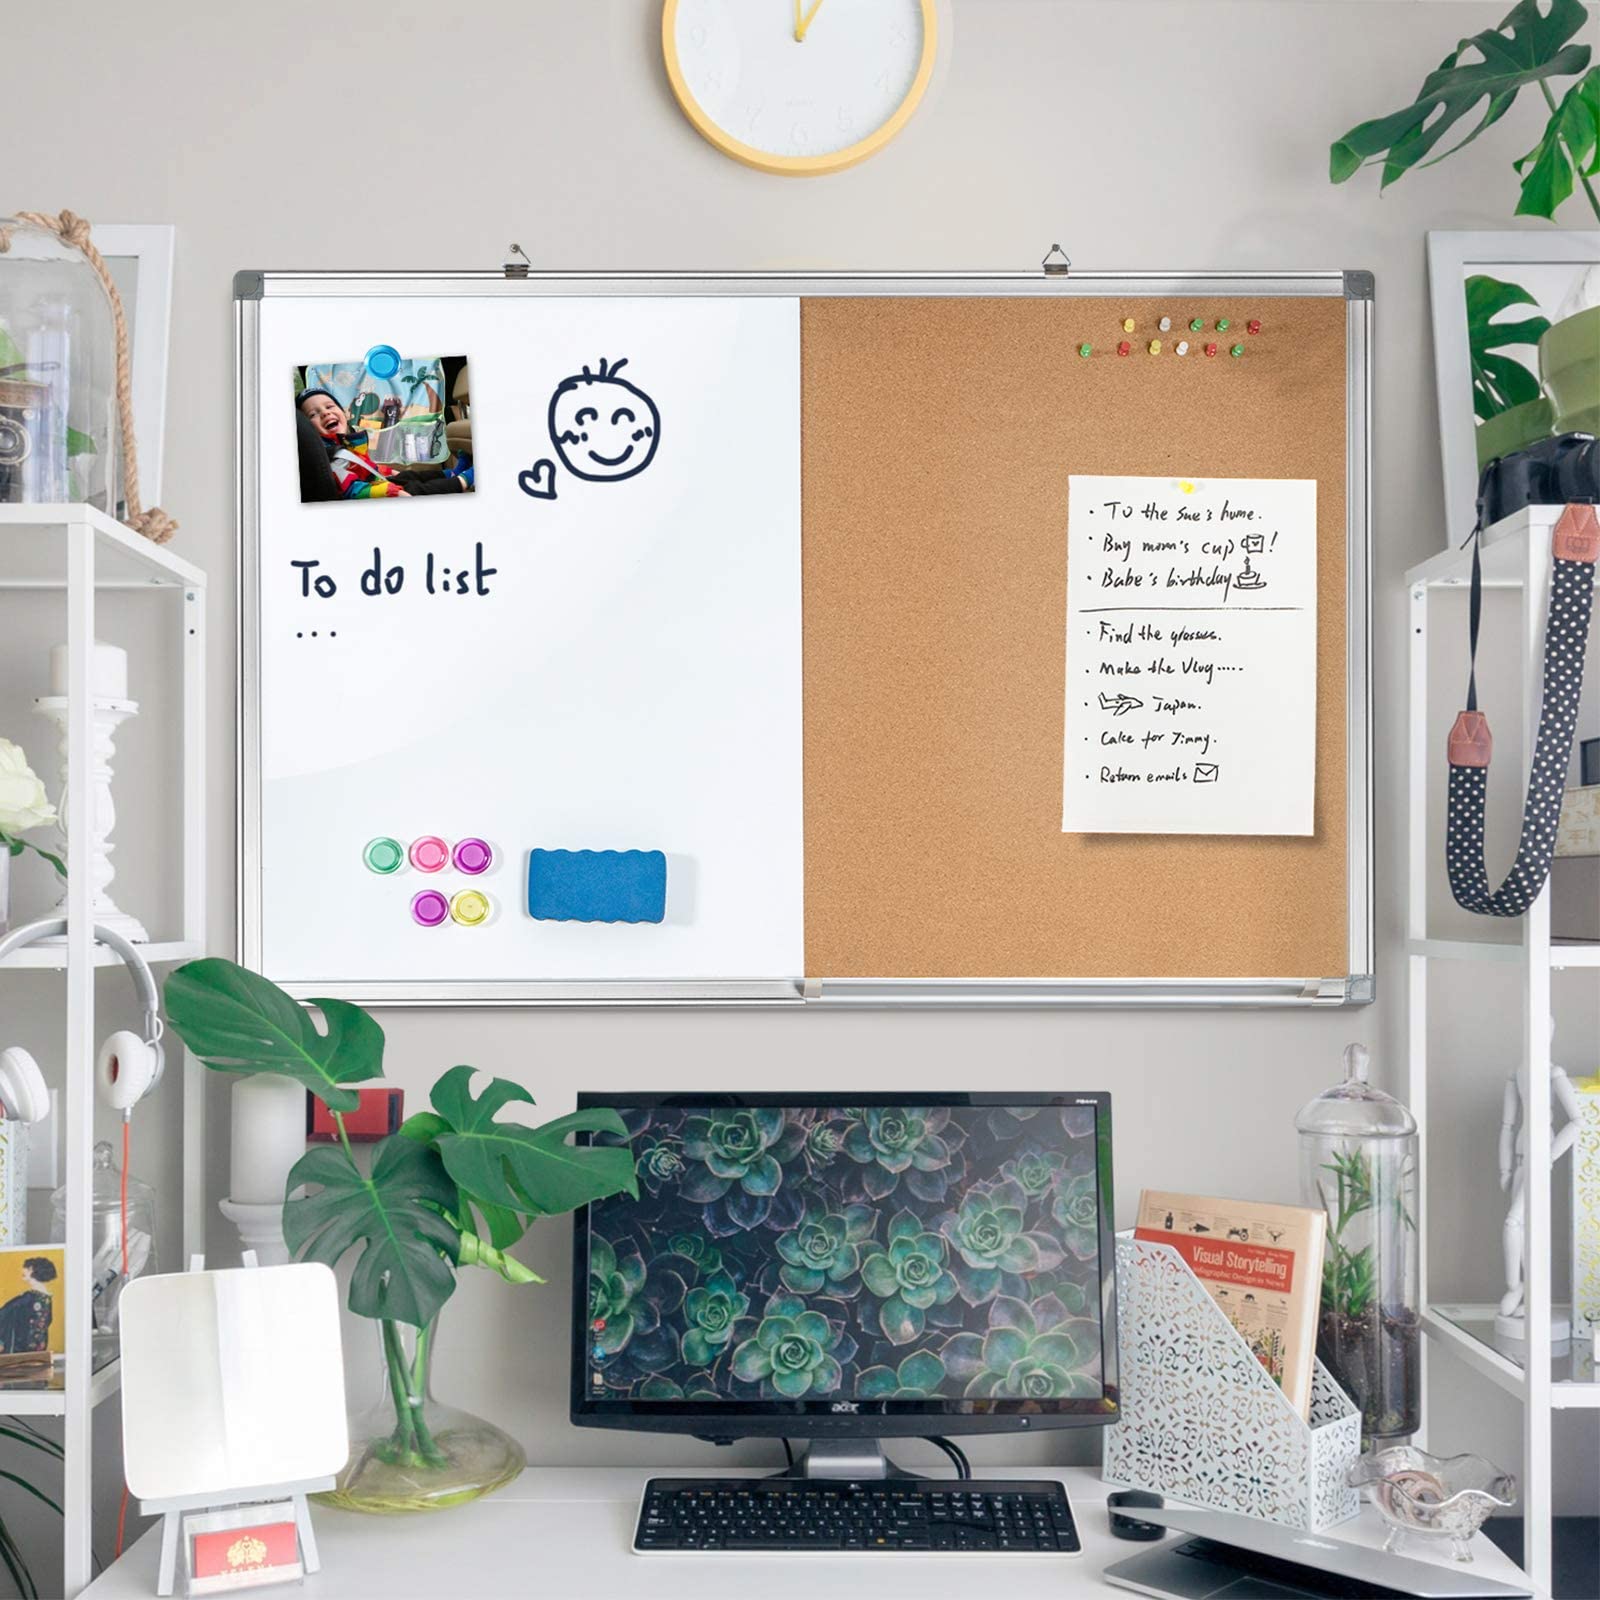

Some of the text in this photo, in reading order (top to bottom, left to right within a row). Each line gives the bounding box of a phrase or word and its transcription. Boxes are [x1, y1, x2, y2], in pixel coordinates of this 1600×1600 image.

[1140, 501, 1168, 521] the
[1176, 506, 1213, 522] Sue's
[1102, 532, 1131, 562] Buy
[1142, 540, 1189, 554] mom's
[1201, 538, 1235, 561] cup
[290, 541, 498, 599] To do list
[1101, 565, 1232, 603] Babe's birthday
[1099, 620, 1134, 645] Find
[1138, 623, 1163, 641] the
[1099, 661, 1142, 676] Make
[1147, 657, 1175, 675] the
[1152, 695, 1202, 716] Japan.
[1100, 730, 1217, 755] Cake for Jimmy.
[1100, 765, 1188, 783] Return emails
[1192, 1245, 1225, 1267] Visual
[1226, 1250, 1288, 1280] Storytelling
